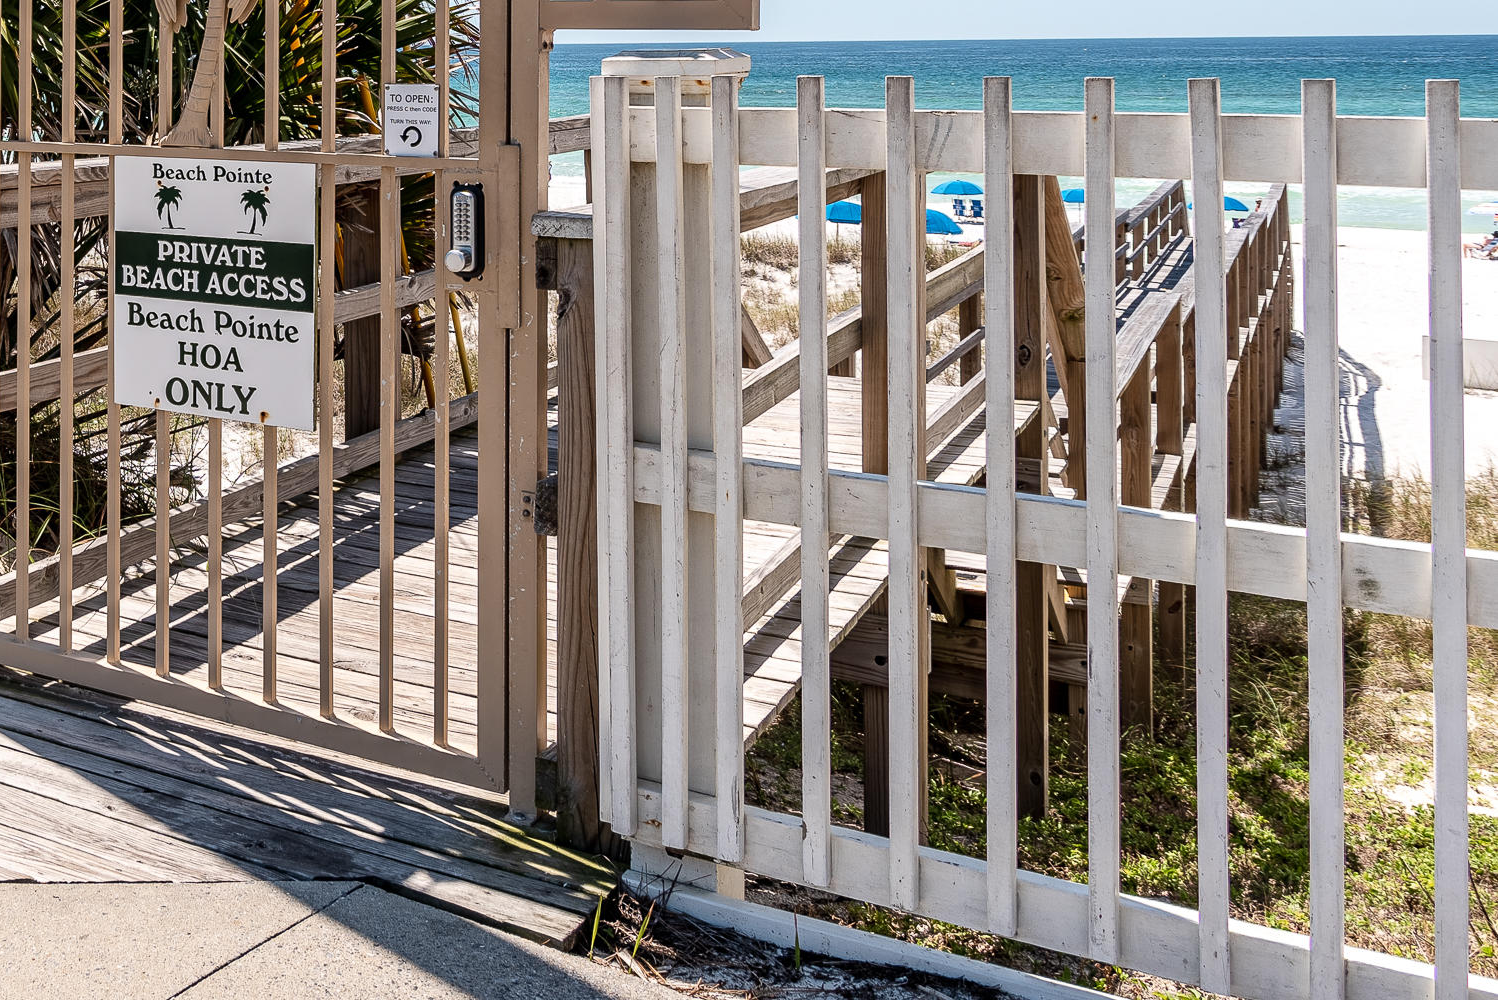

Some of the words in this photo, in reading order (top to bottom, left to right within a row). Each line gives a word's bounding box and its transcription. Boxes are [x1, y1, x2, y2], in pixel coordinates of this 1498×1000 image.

[389, 93, 403, 103] TO
[405, 94, 434, 104] OPEN:
[152, 163, 207, 181] Beach
[213, 165, 273, 184] Pointe
[157, 240, 267, 270] PRIVATE
[121, 264, 200, 293] BEACH
[205, 271, 306, 302] ACCESS
[127, 302, 205, 333] Beach
[213, 310, 300, 343] Pointe
[177, 341, 244, 373] HOA
[165, 377, 256, 415] ONLY
